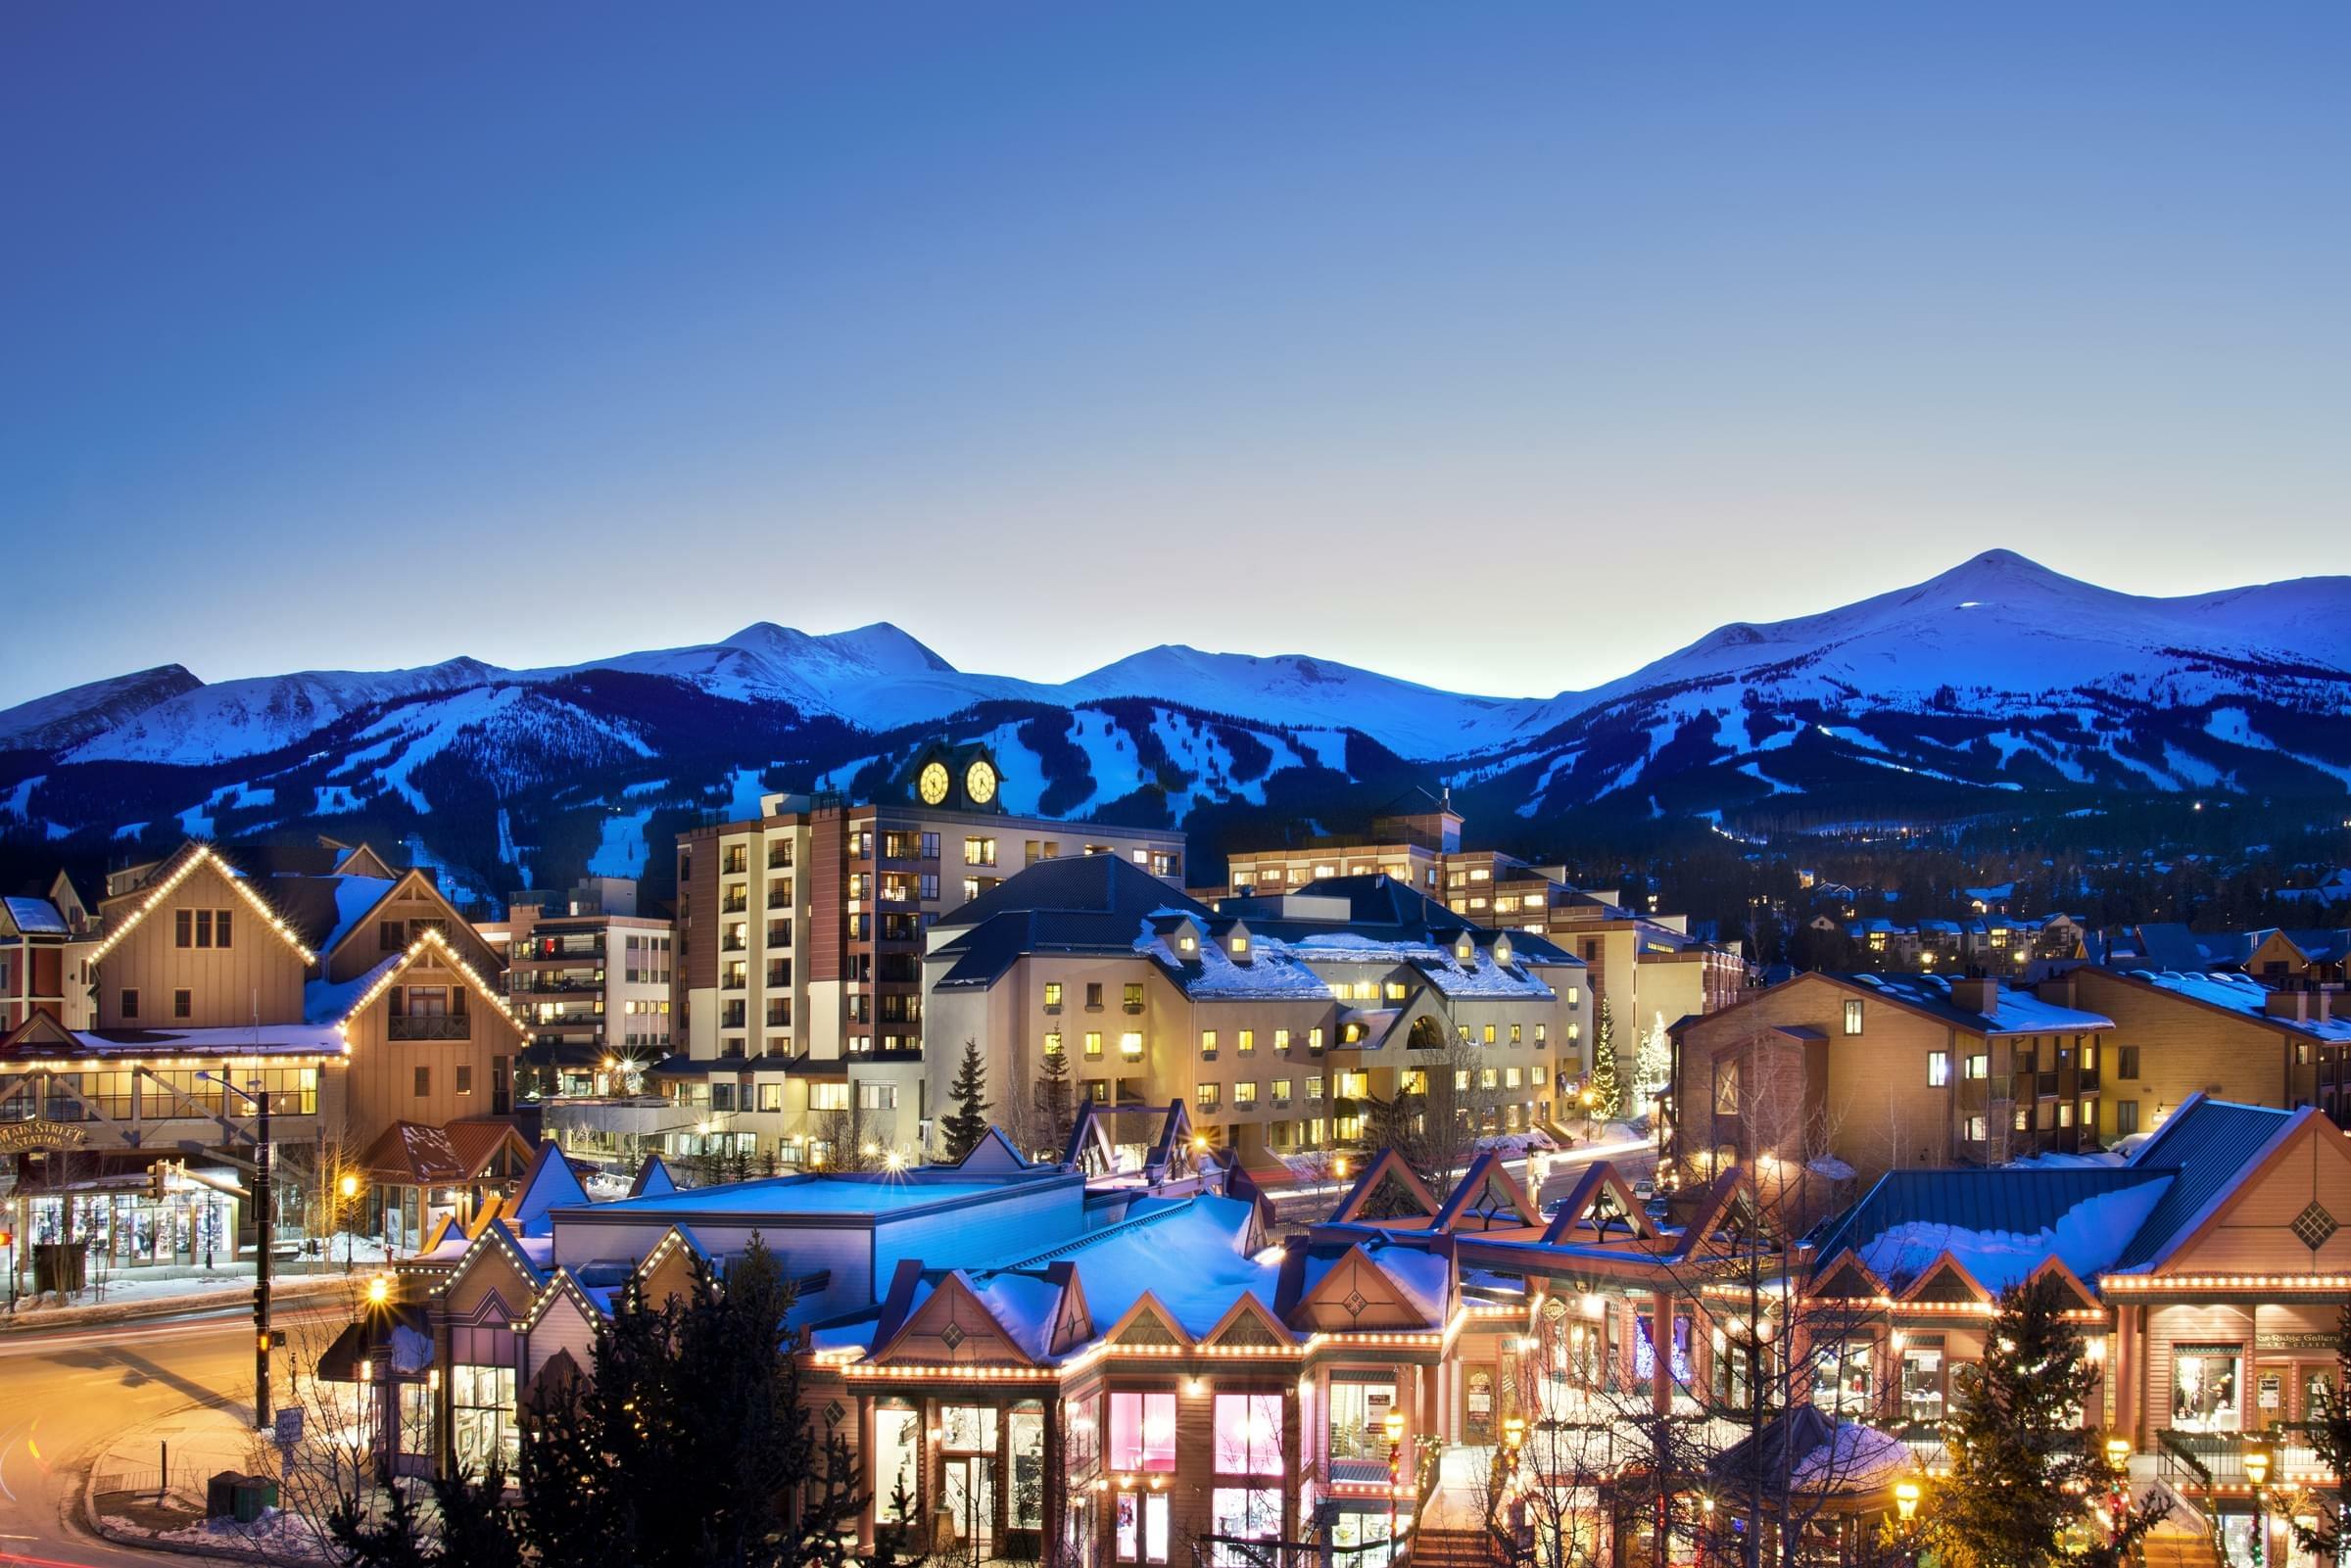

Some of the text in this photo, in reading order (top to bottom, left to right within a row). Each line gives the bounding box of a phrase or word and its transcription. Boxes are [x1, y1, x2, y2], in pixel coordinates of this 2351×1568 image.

[0, 1122, 86, 1143] MAIN STREET
[14, 1135, 64, 1147] STATION
[2272, 1334, 2301, 1344] Ridge
[2304, 1334, 2340, 1343] Gallery
